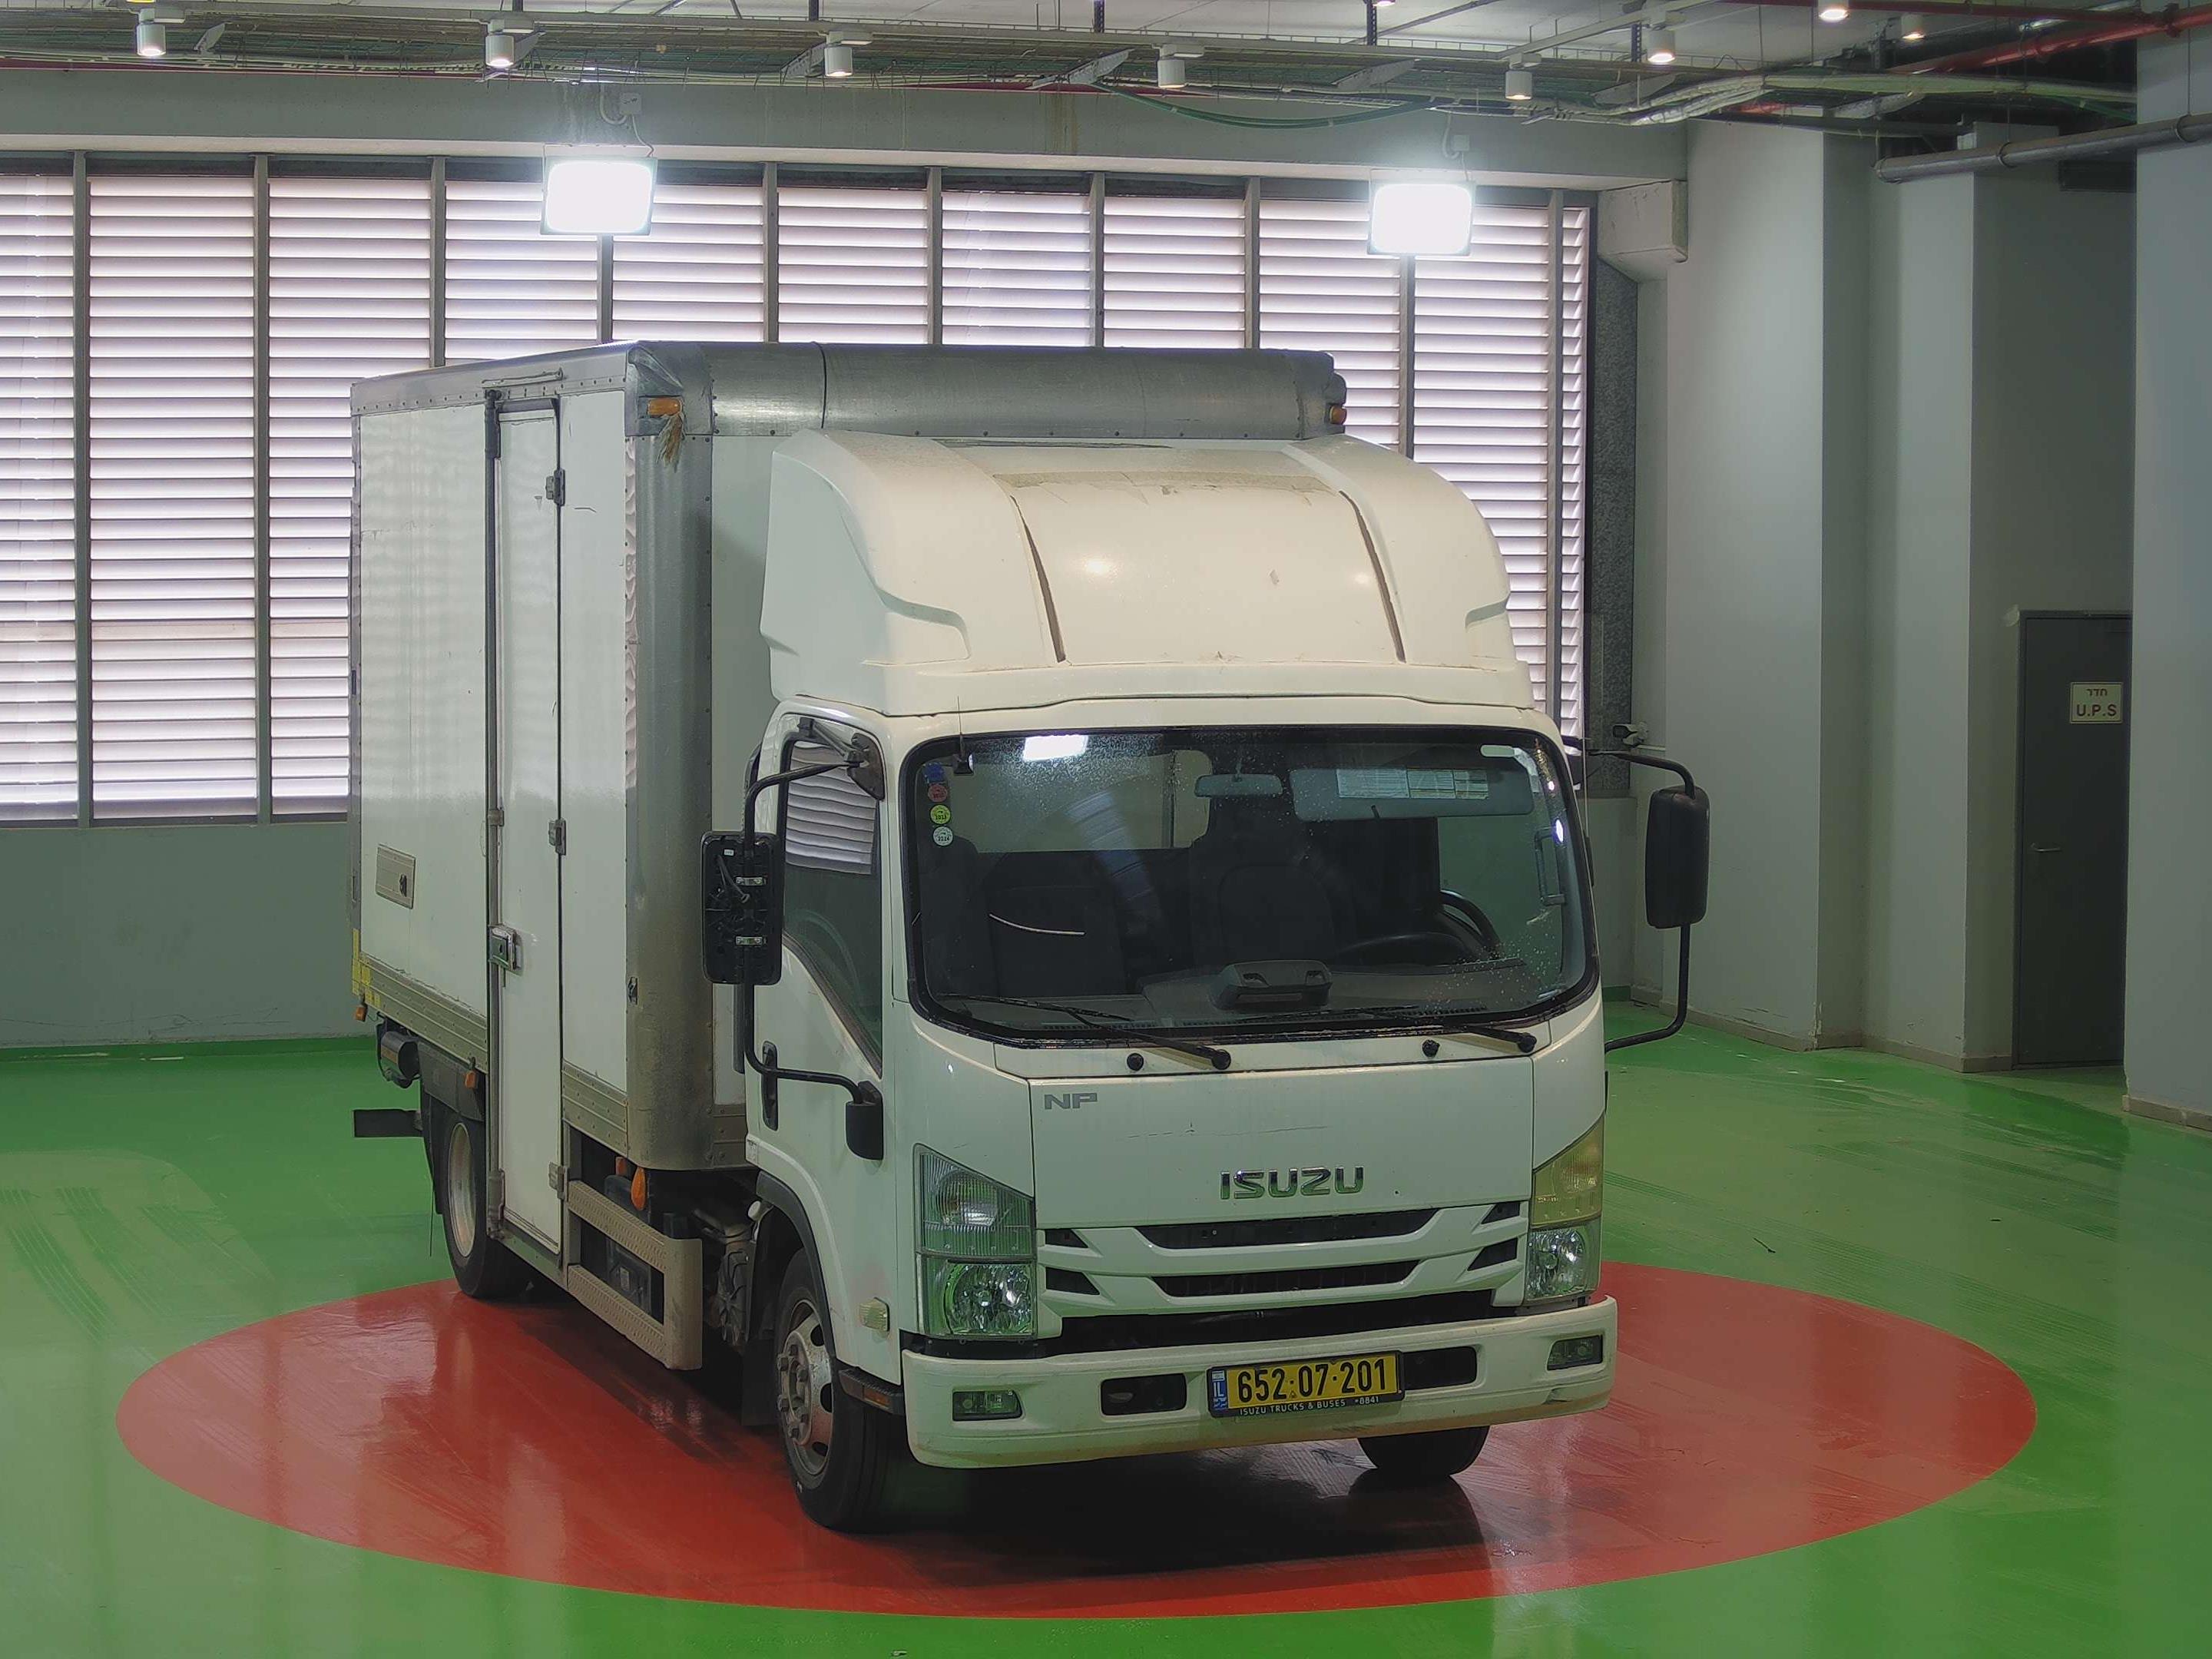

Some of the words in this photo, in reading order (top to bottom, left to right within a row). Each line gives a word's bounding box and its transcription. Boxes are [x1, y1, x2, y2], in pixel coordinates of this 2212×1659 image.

[2086, 688, 2108, 697] חדר
[2076, 704, 2118, 717] U.P.S
[1045, 1092, 1098, 1110] NP
[1220, 1165, 1364, 1200] ISUZU
[1214, 1382, 1225, 1398] IL
[1240, 1406, 1267, 1416] ISUZU
[1270, 1402, 1304, 1413] TRUCKS
[1316, 1399, 1346, 1409] BUSES
